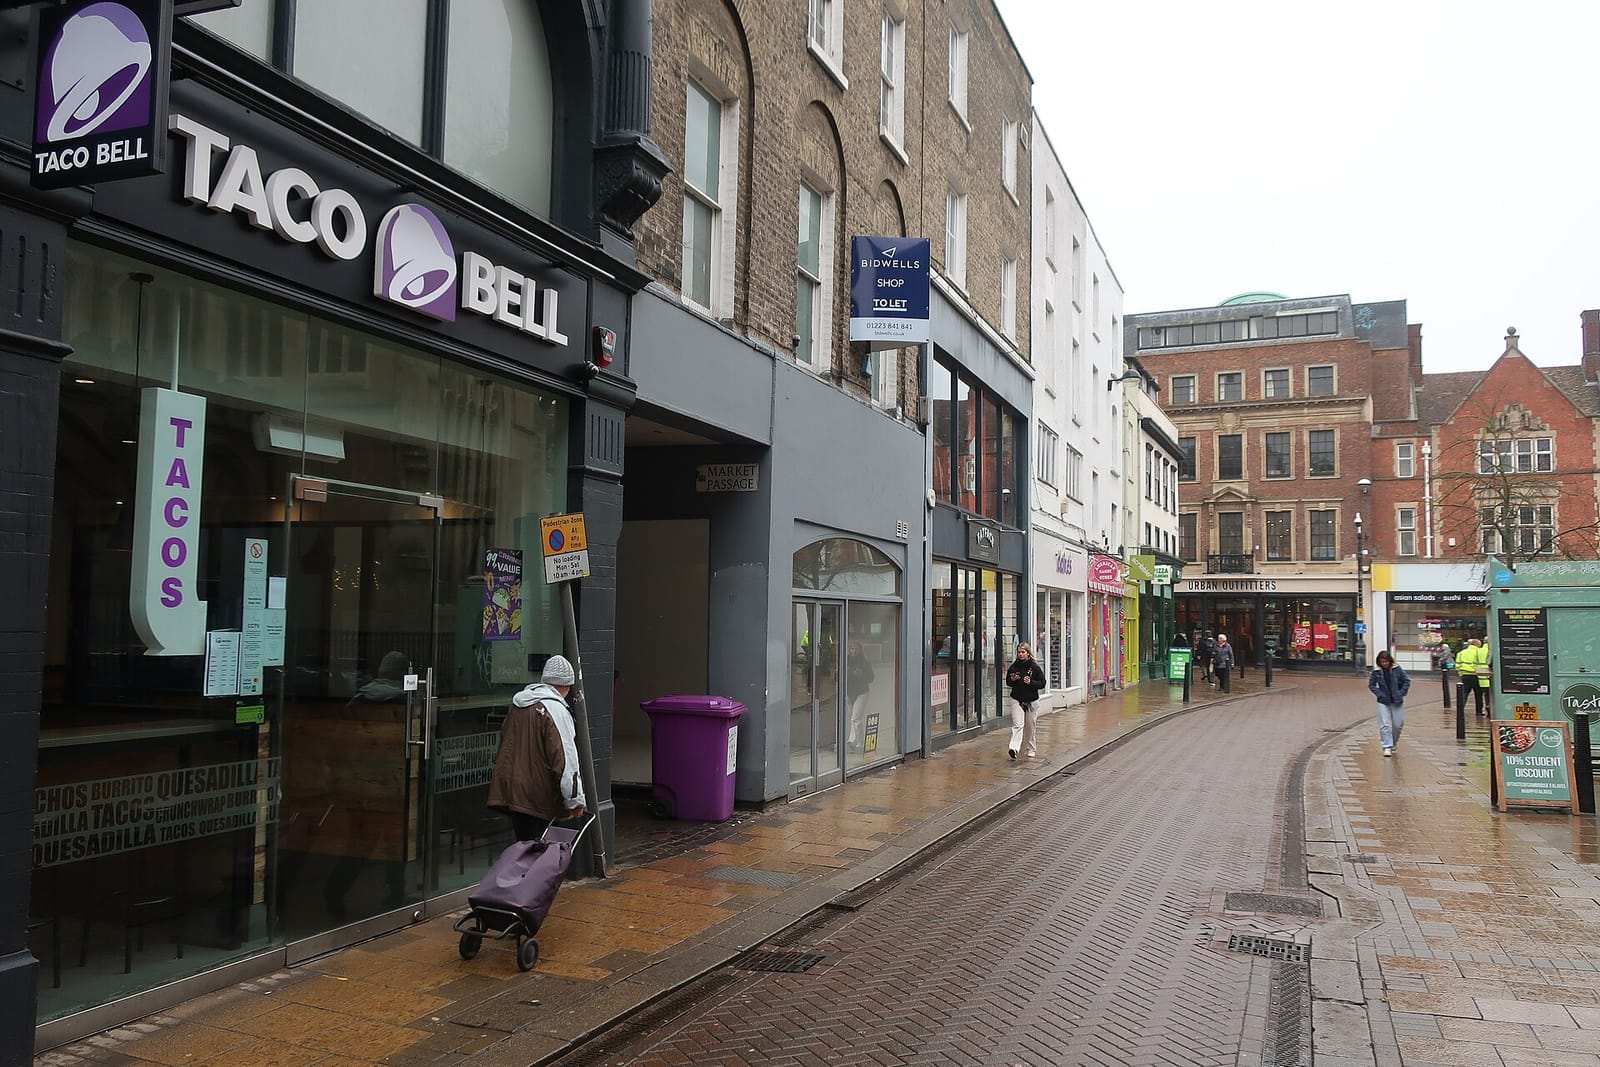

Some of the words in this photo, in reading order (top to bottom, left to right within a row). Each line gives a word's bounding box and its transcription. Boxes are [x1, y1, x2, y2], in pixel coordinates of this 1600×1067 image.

[35, 146, 90, 174] TACO
[96, 138, 148, 165] BELL
[168, 113, 367, 260] TACO
[462, 251, 568, 346] BELL
[861, 259, 920, 269] BIDWELLS
[877, 279, 905, 288] SHOP
[873, 299, 888, 308] TO
[889, 299, 907, 308] LET
[707, 465, 757, 477] MARKET
[707, 479, 754, 490] PASSAGE
[160, 417, 193, 608] TACOS
[543, 519, 570, 527] Pedestrian
[497, 562, 521, 574] VALUE
[1095, 560, 1116, 571] AMERICAN
[1188, 580, 1218, 591] URBAN
[1222, 580, 1277, 591] OUTFITTERS
[1506, 755, 1524, 766] 10%
[1525, 756, 1562, 767] STUDENT
[1514, 768, 1555, 778] DISCOUNT
[91, 775, 153, 801] BURRITO
[91, 797, 155, 829] TACOS
[155, 795, 226, 824] CRUNCHWRAP
[32, 823, 156, 867] QUESADILLA
[160, 822, 196, 841] TACOS
